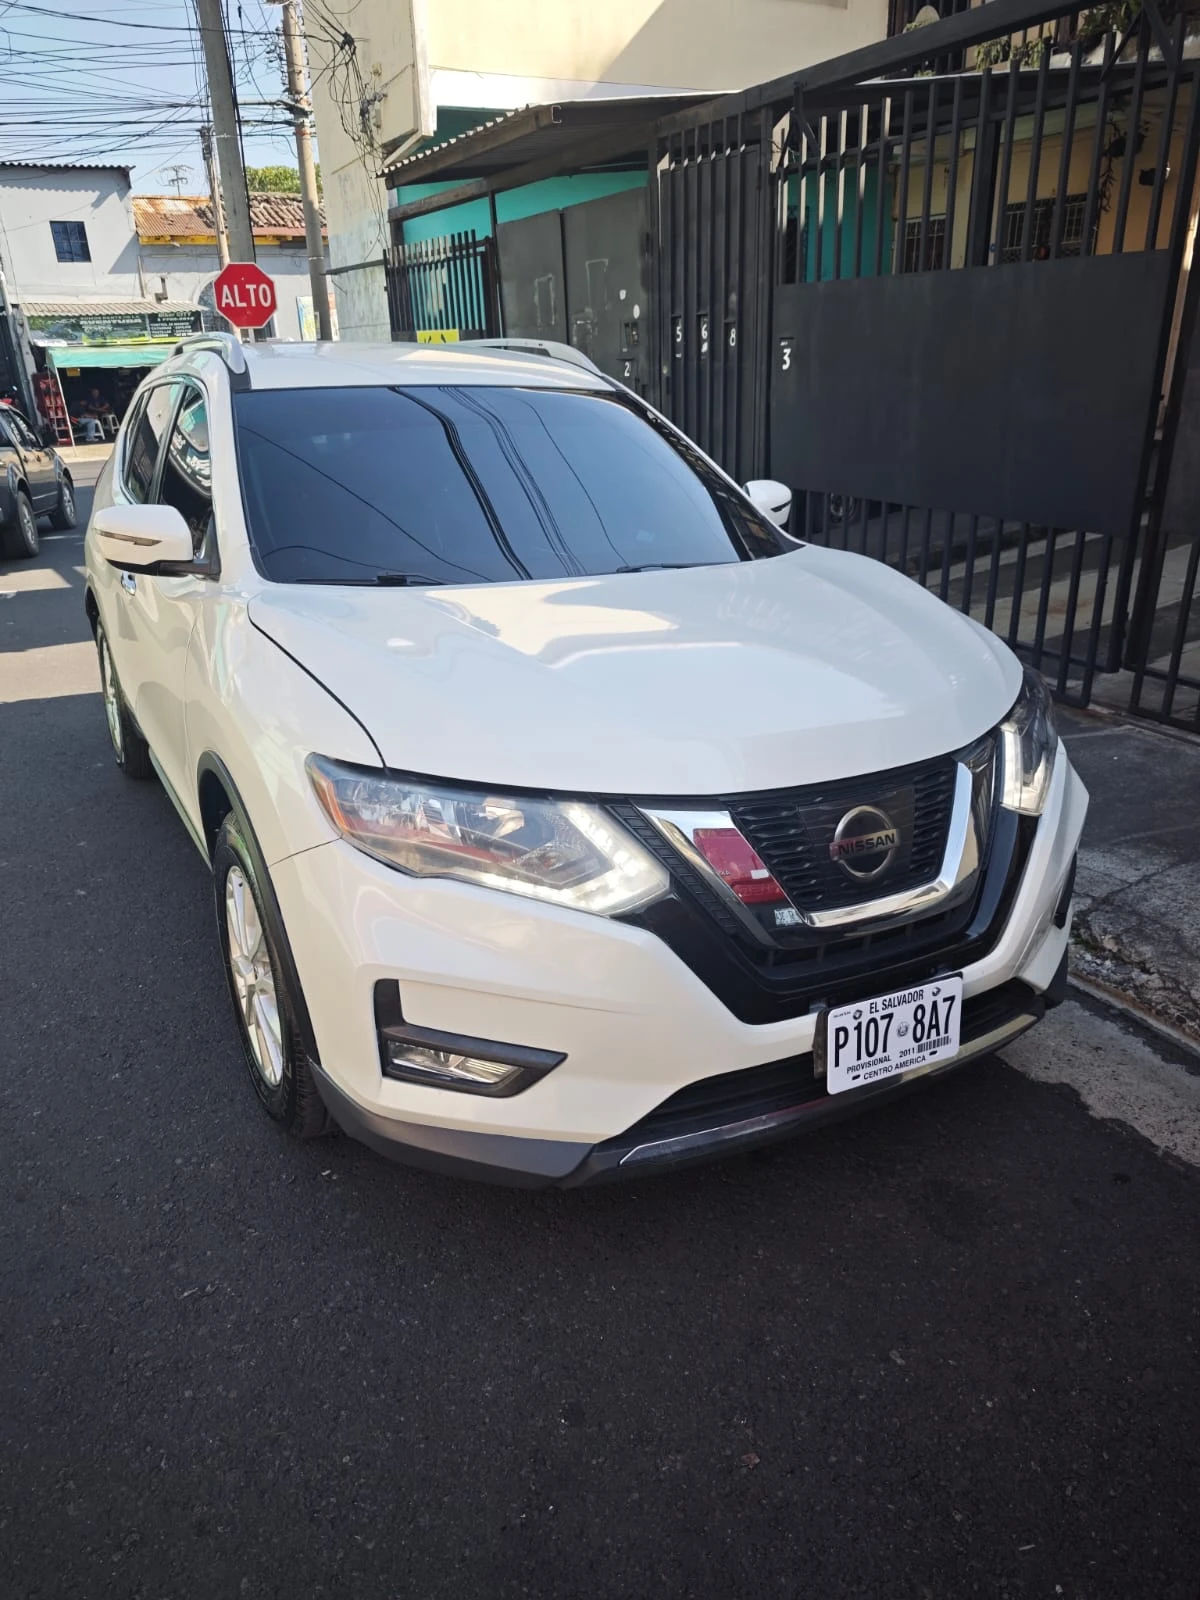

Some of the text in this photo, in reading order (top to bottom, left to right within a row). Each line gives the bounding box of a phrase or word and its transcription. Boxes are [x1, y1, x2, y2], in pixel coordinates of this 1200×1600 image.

[221, 284, 272, 309] ALTO
[676, 326, 683, 342] 5
[701, 324, 708, 339] 6
[729, 328, 736, 346] 8
[624, 361, 630, 377] 2
[781, 348, 791, 371] 3
[837, 832, 896, 855] NISSAN
[869, 989, 924, 1014] EL SALVADOR
[834, 995, 956, 1068] P107 8A7
[846, 1047, 916, 1074] PROVISIONAL 2011
[863, 1055, 926, 1080] CENTRO AMERICA
